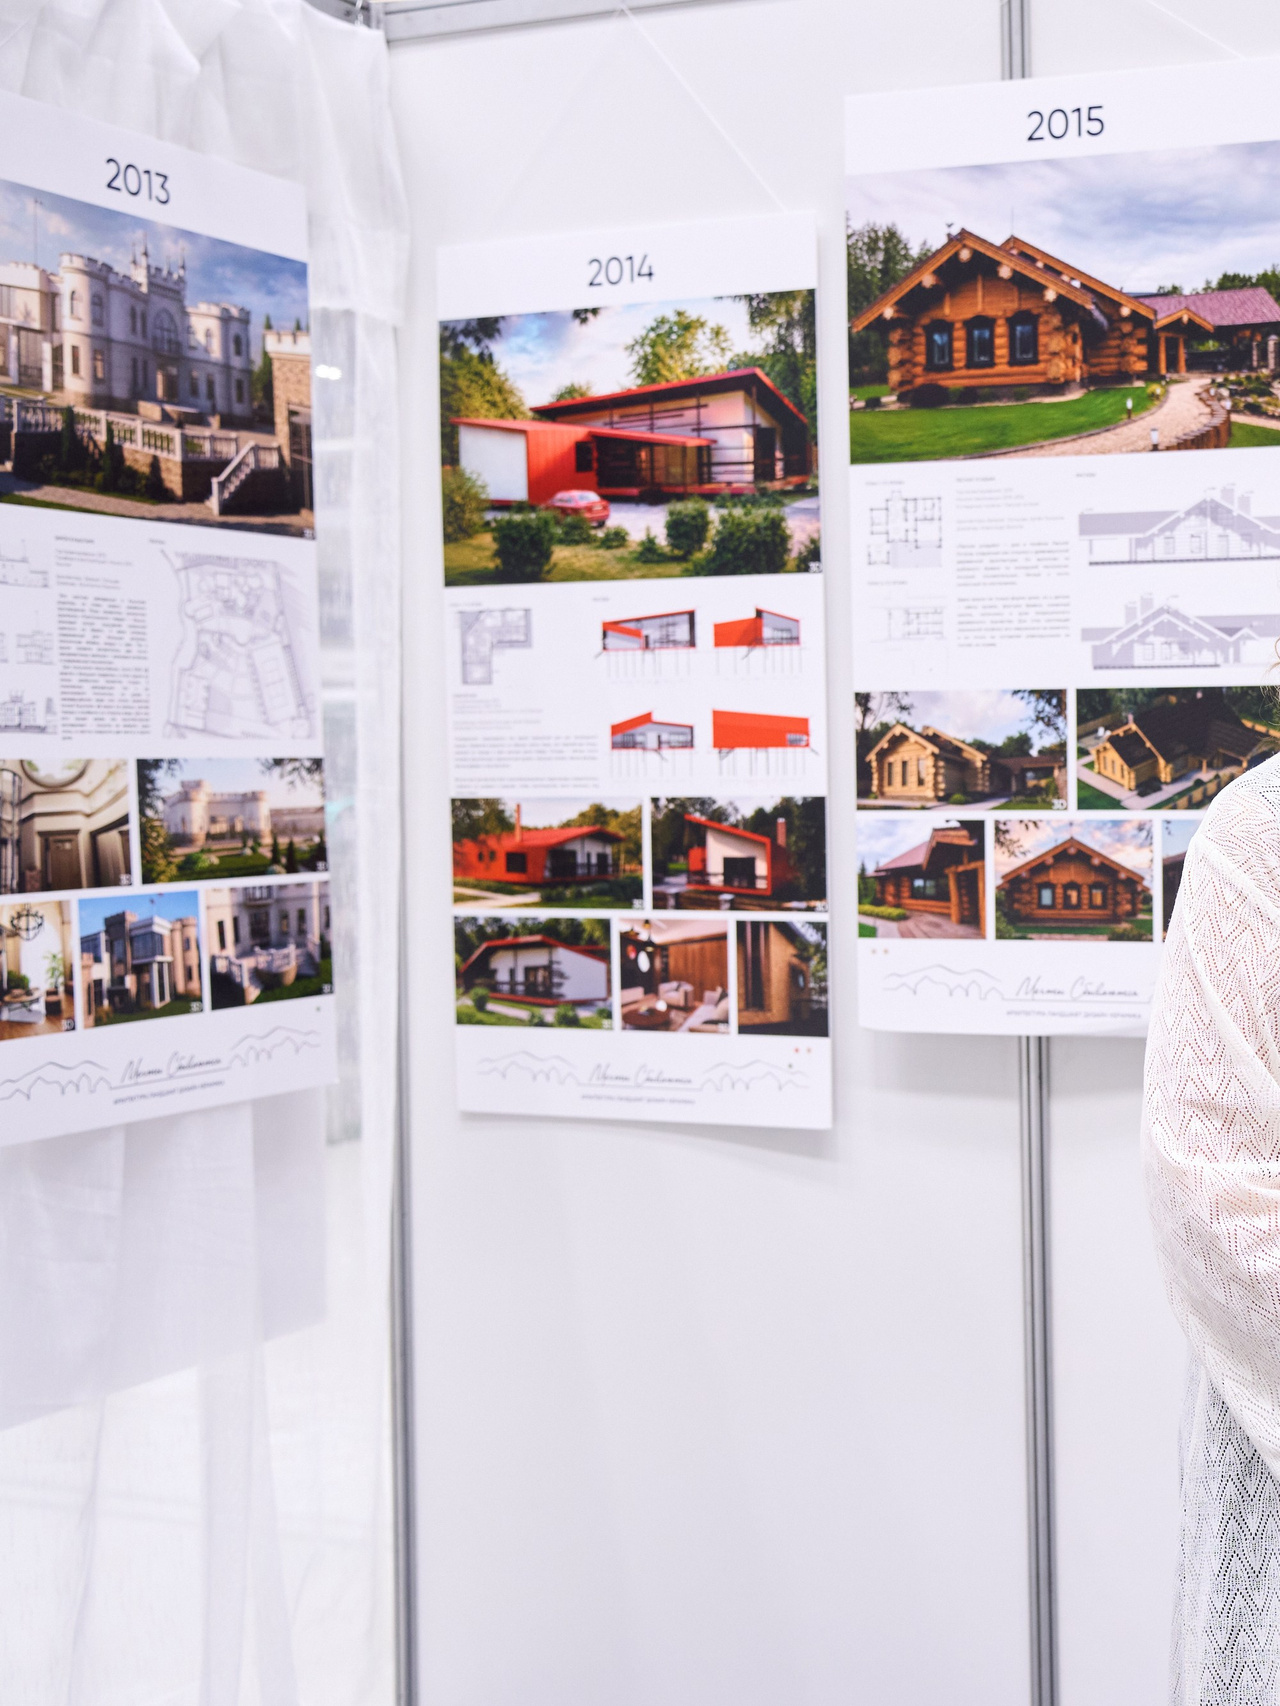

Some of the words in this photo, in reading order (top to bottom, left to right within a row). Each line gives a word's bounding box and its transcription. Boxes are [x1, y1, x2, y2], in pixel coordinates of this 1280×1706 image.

[1028, 106, 1103, 141] 2015
[106, 158, 170, 205] 2013
[589, 257, 653, 286] 2014
